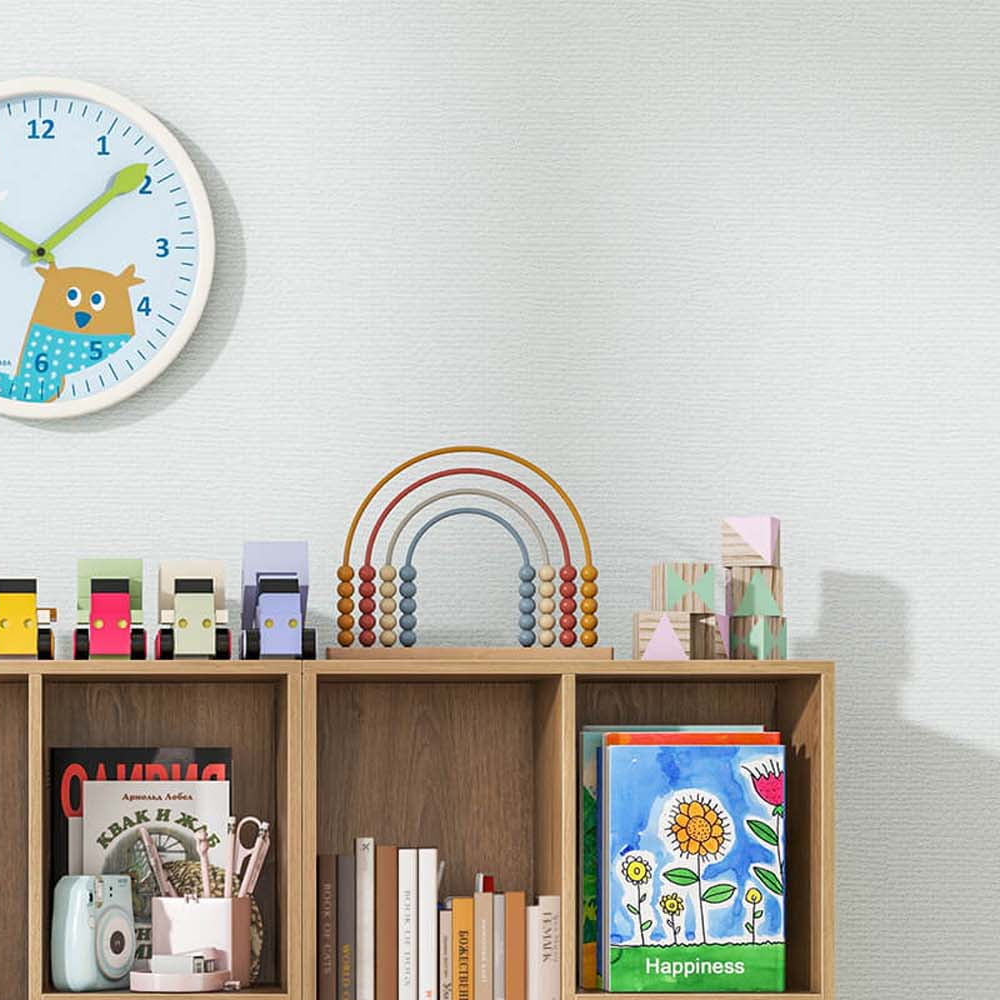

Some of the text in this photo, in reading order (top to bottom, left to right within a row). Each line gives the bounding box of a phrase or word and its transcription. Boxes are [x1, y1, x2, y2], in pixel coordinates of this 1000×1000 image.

[27, 119, 55, 140] 12
[97, 136, 110, 156] 1
[139, 175, 153, 195] 2
[155, 238, 169, 258] 3
[136, 296, 151, 317] 4
[90, 341, 103, 361] 5
[35, 353, 48, 373] 6
[121, 791, 193, 802] Арнольд Лобел
[96, 809, 151, 850] КВАК
[156, 808, 171, 822] И
[645, 957, 745, 977] Happiness
